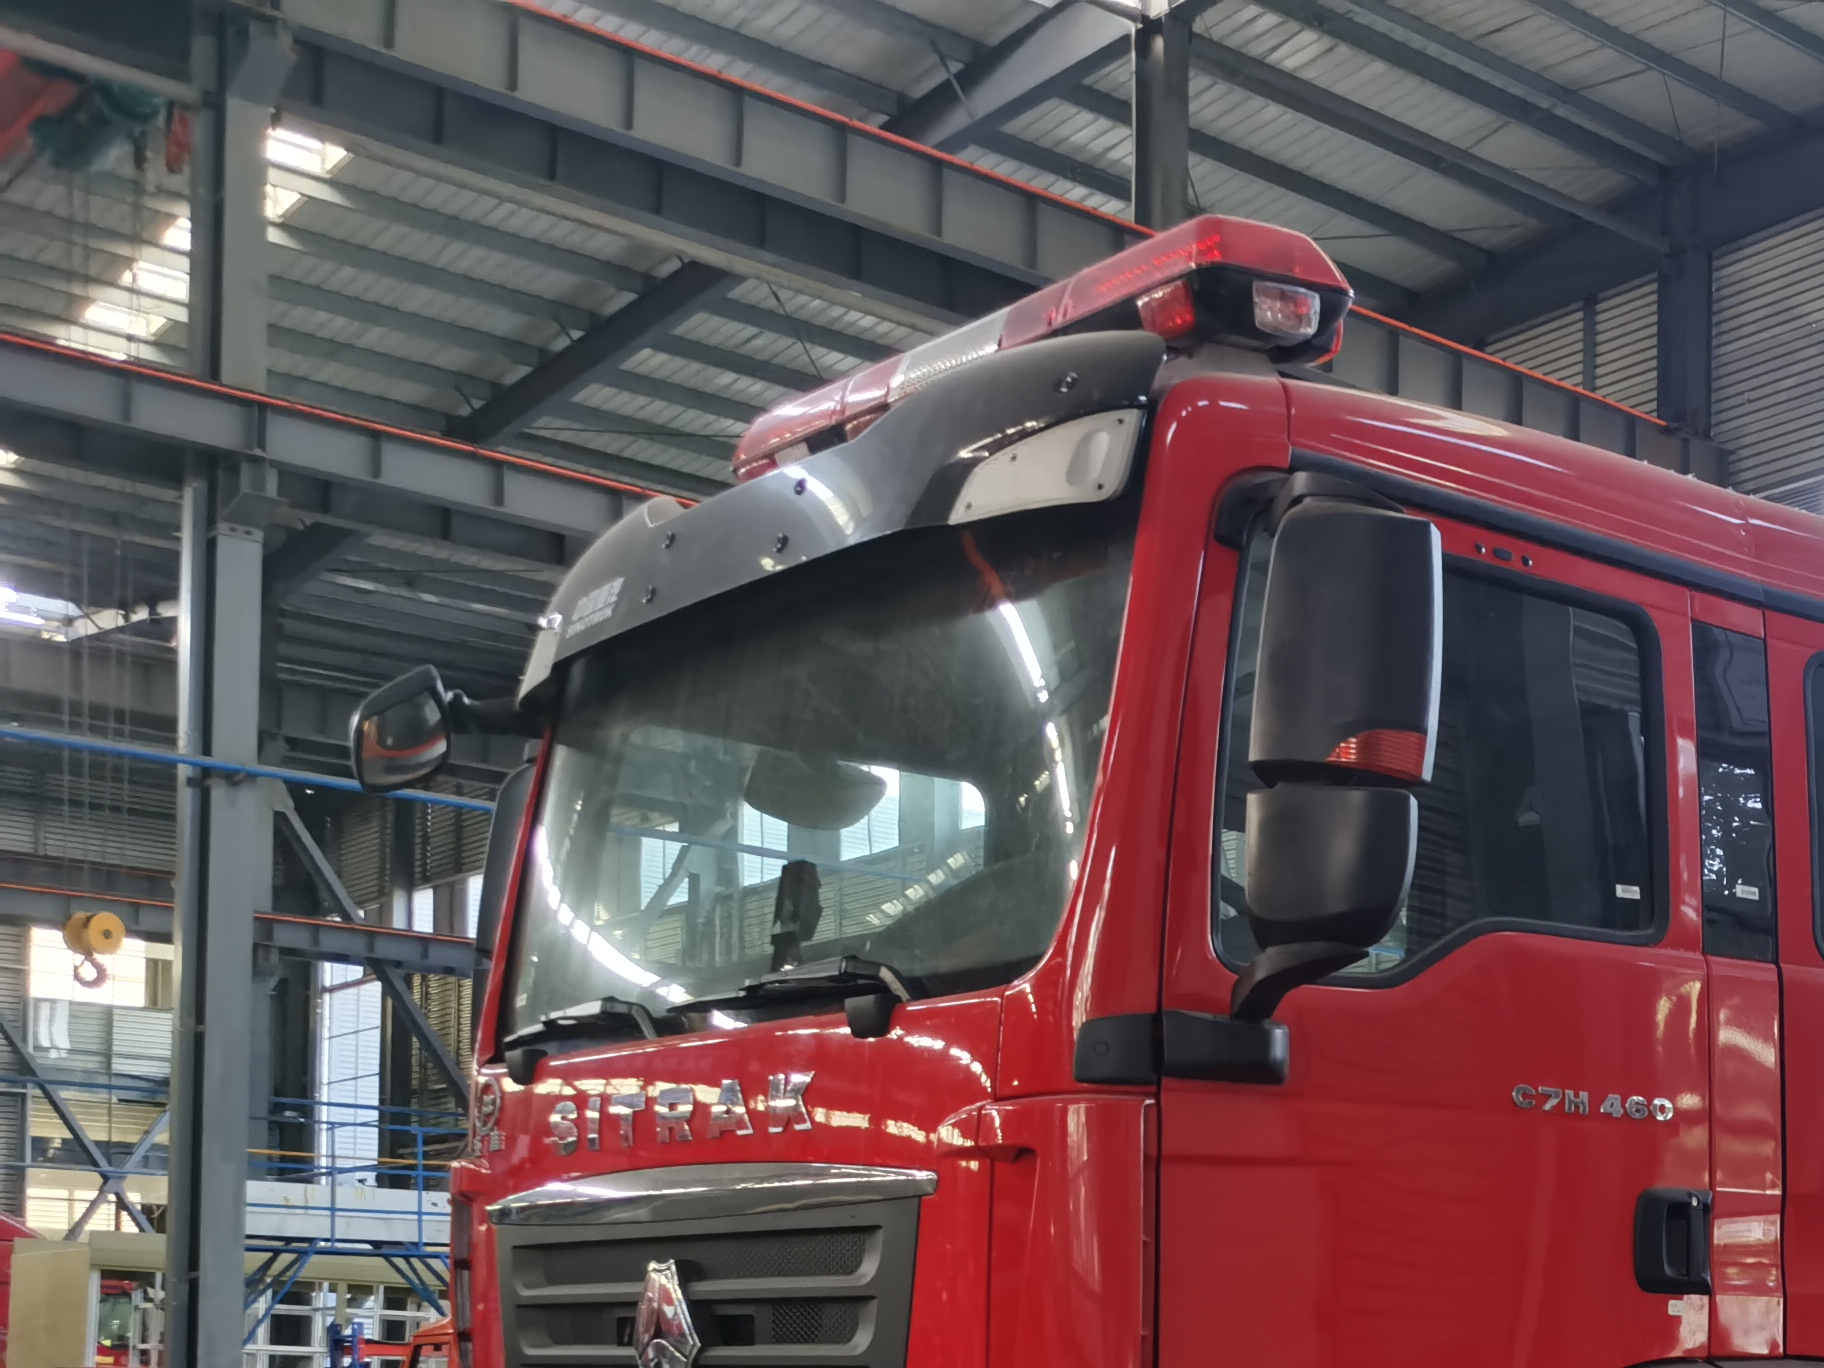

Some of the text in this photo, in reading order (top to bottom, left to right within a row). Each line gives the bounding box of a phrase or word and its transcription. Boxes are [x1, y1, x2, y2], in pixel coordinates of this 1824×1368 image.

[549, 1071, 815, 1156] SITRAK
[1512, 1084, 1674, 1121] C7H 460
